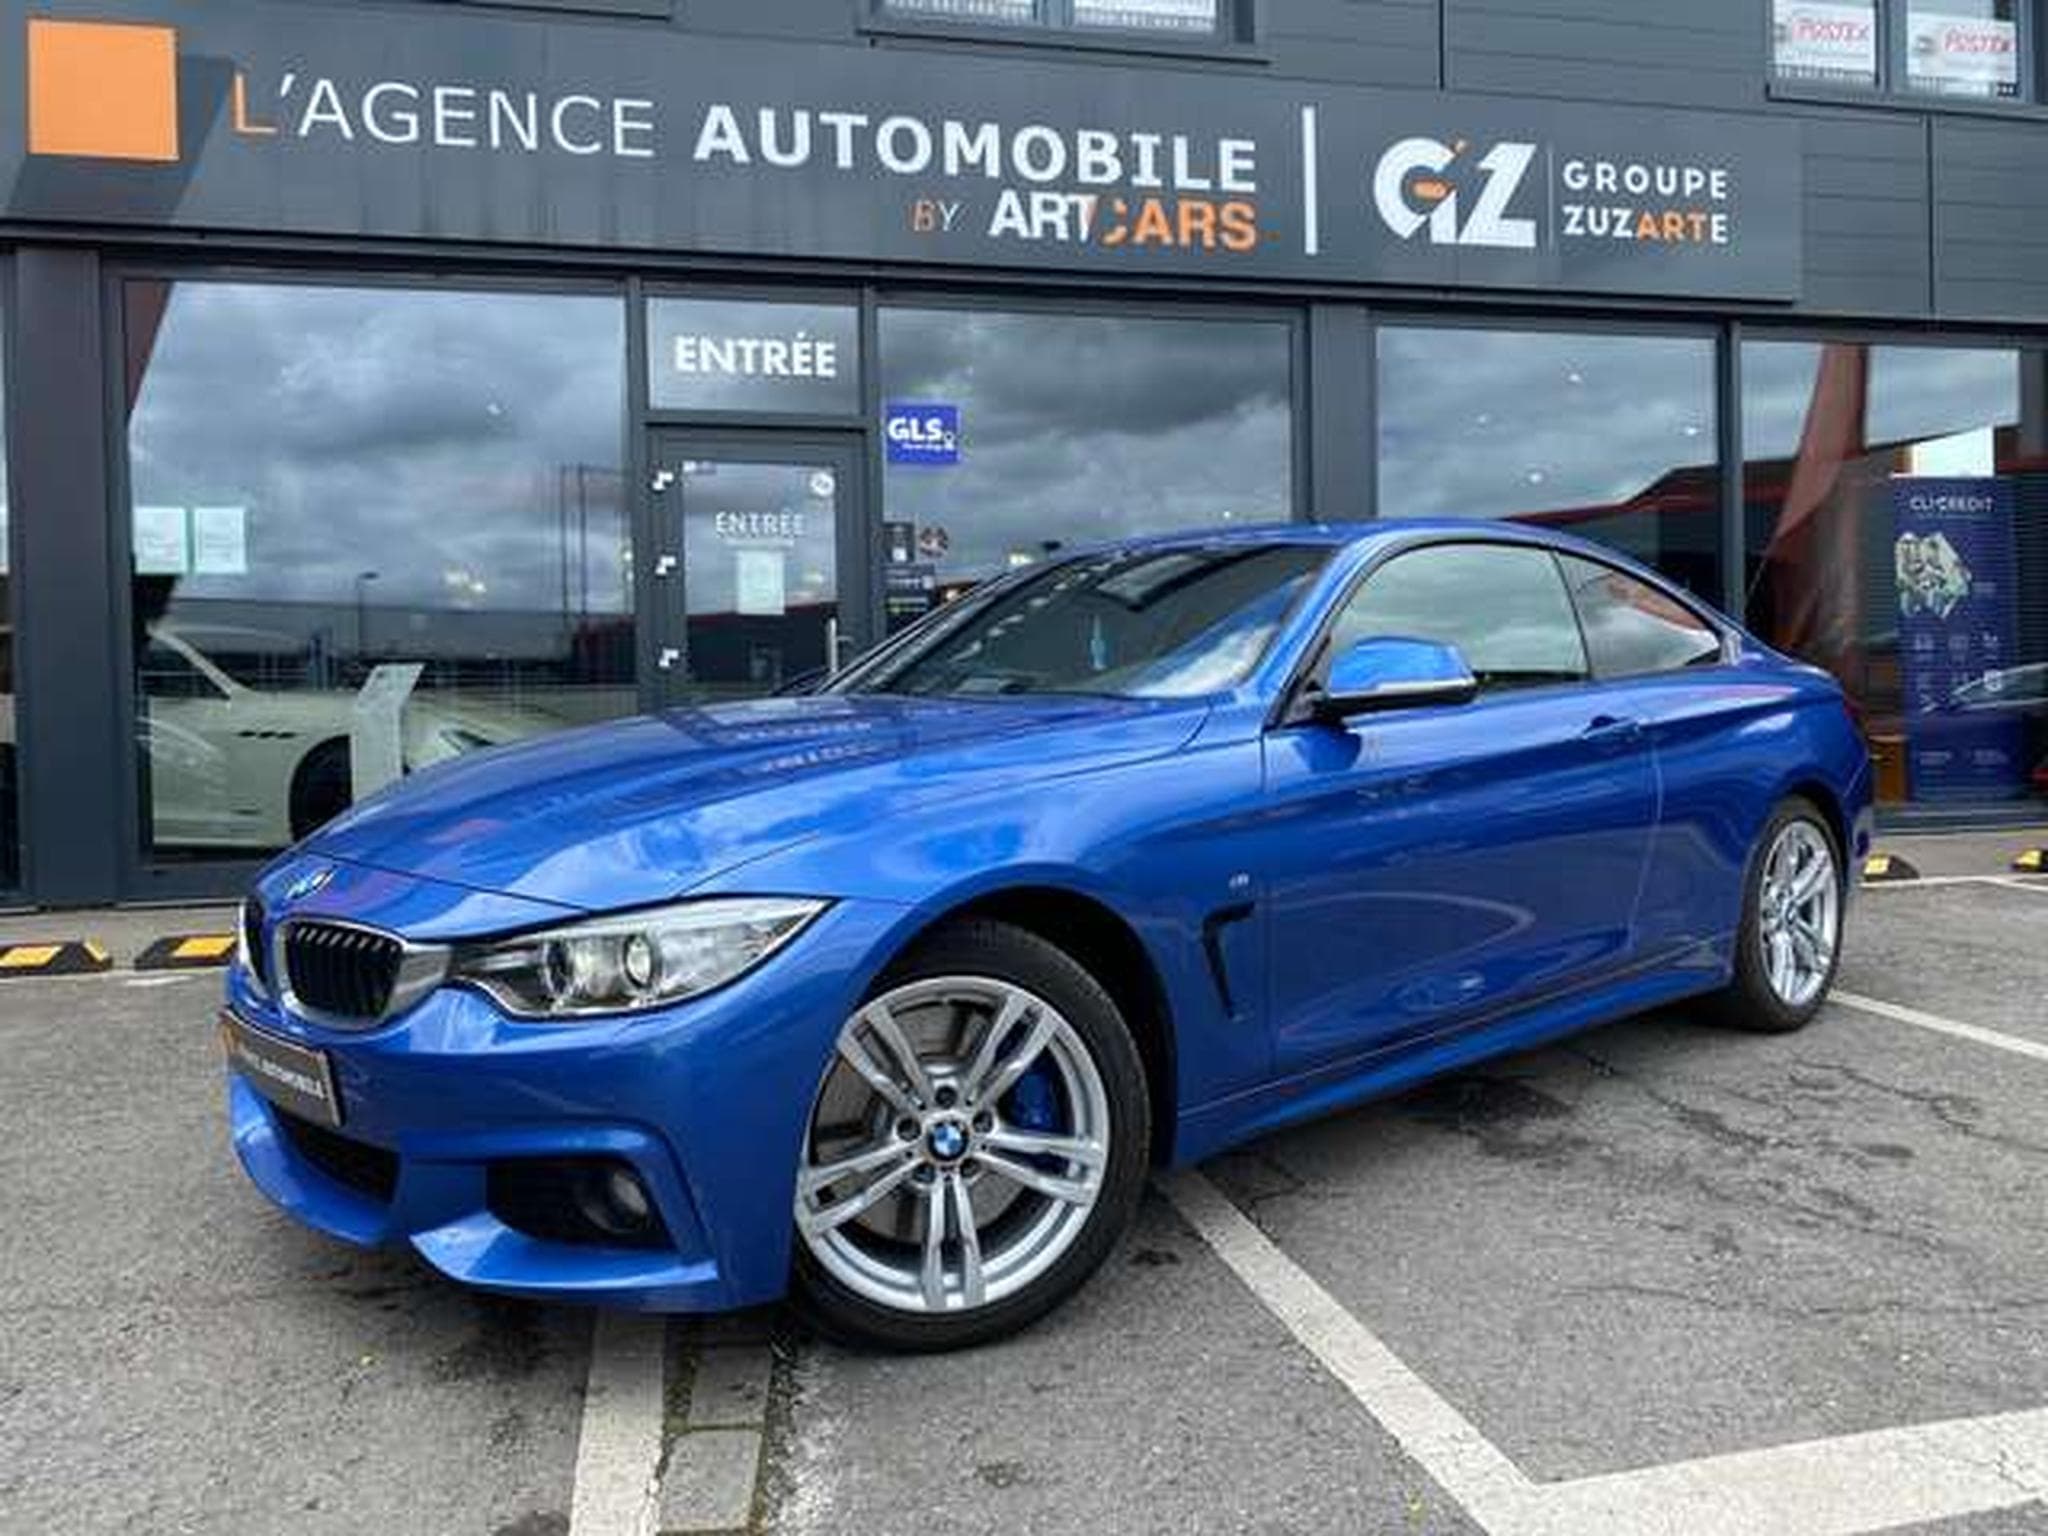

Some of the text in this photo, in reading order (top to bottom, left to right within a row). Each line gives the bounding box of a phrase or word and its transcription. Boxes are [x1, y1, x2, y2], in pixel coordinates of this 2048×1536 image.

[232, 72, 1257, 193] L'AGENCE AUTOMOBILE
[1562, 160, 1729, 199] GROUPE
[914, 198, 961, 232] BY
[1562, 204, 1729, 244] ZUZARTE
[674, 330, 838, 379] ENTRÉE
[888, 416, 943, 441] GLS
